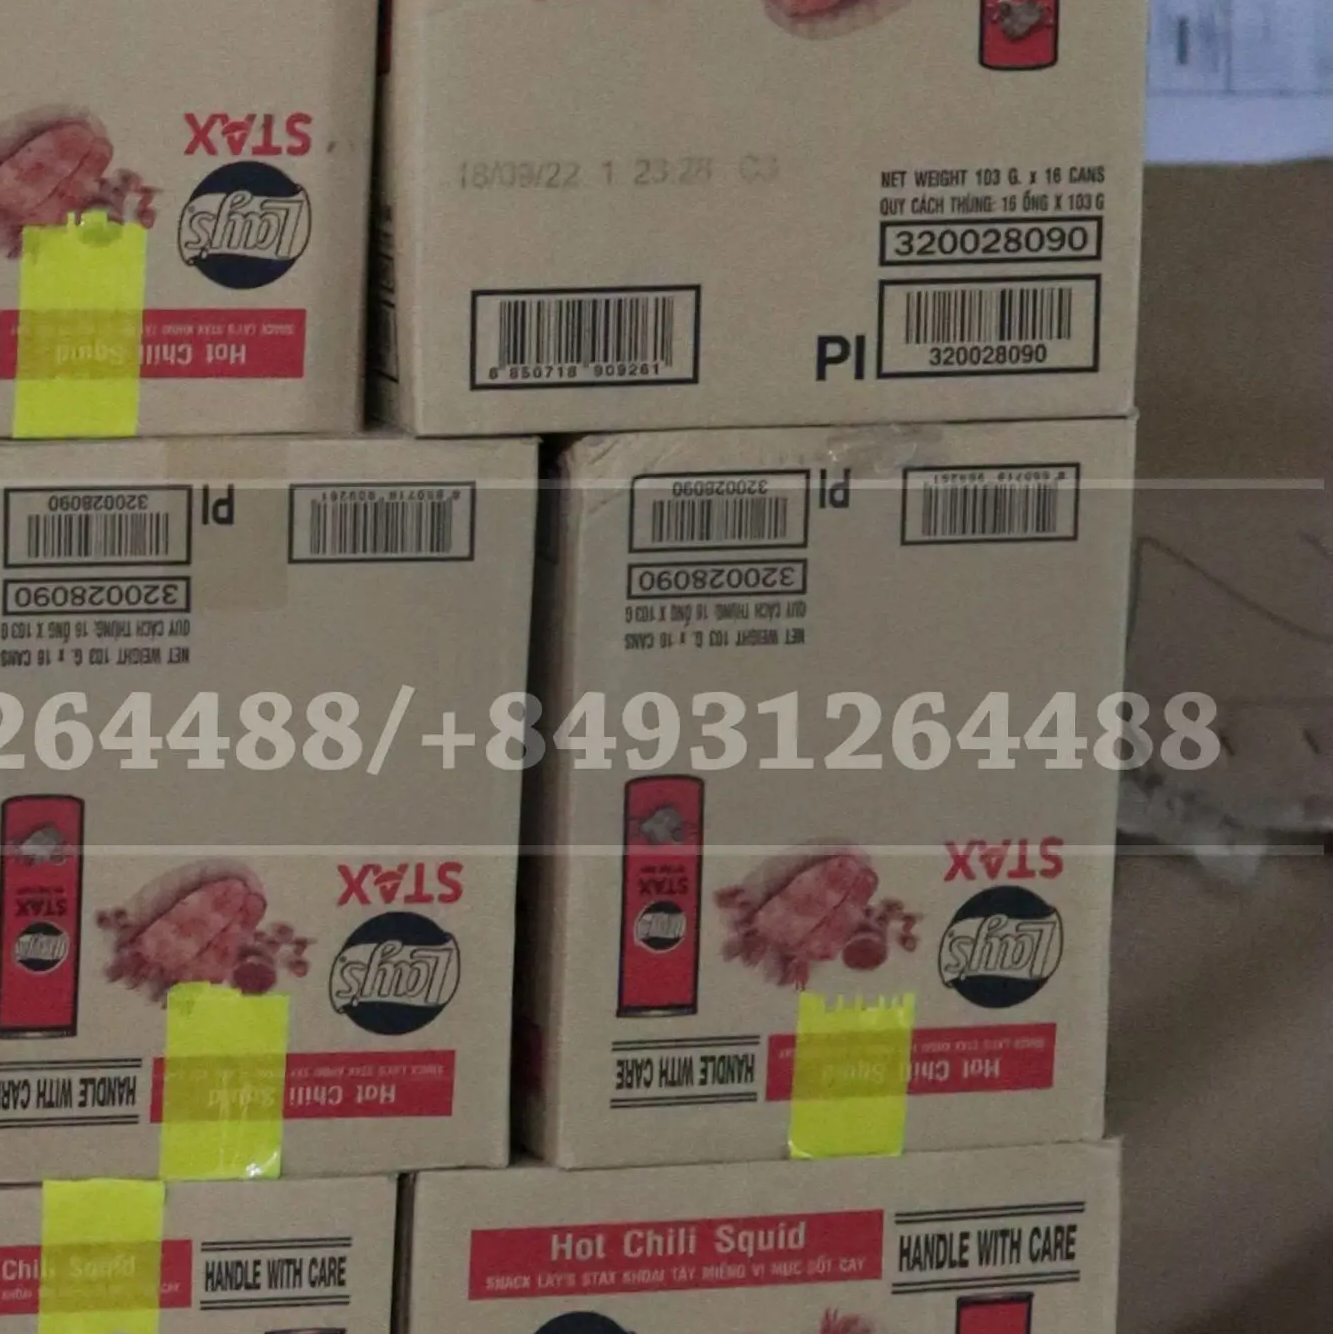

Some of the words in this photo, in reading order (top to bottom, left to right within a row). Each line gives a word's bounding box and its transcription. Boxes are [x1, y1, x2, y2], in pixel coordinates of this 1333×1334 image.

[185, 113, 310, 155] STAX
[895, 227, 1088, 256] 320028090
[15, 584, 178, 607] 320028090
[639, 567, 794, 591] 320028090
[945, 838, 1063, 881] STAX
[340, 863, 462, 905] STAX
[552, 1234, 604, 1260] Hot
[624, 1228, 696, 1257] Chili
[716, 1222, 805, 1257] Squid
[899, 1232, 970, 1271] HANDLE
[978, 1229, 1021, 1265] WITH
[1029, 1225, 1077, 1263] CARE
